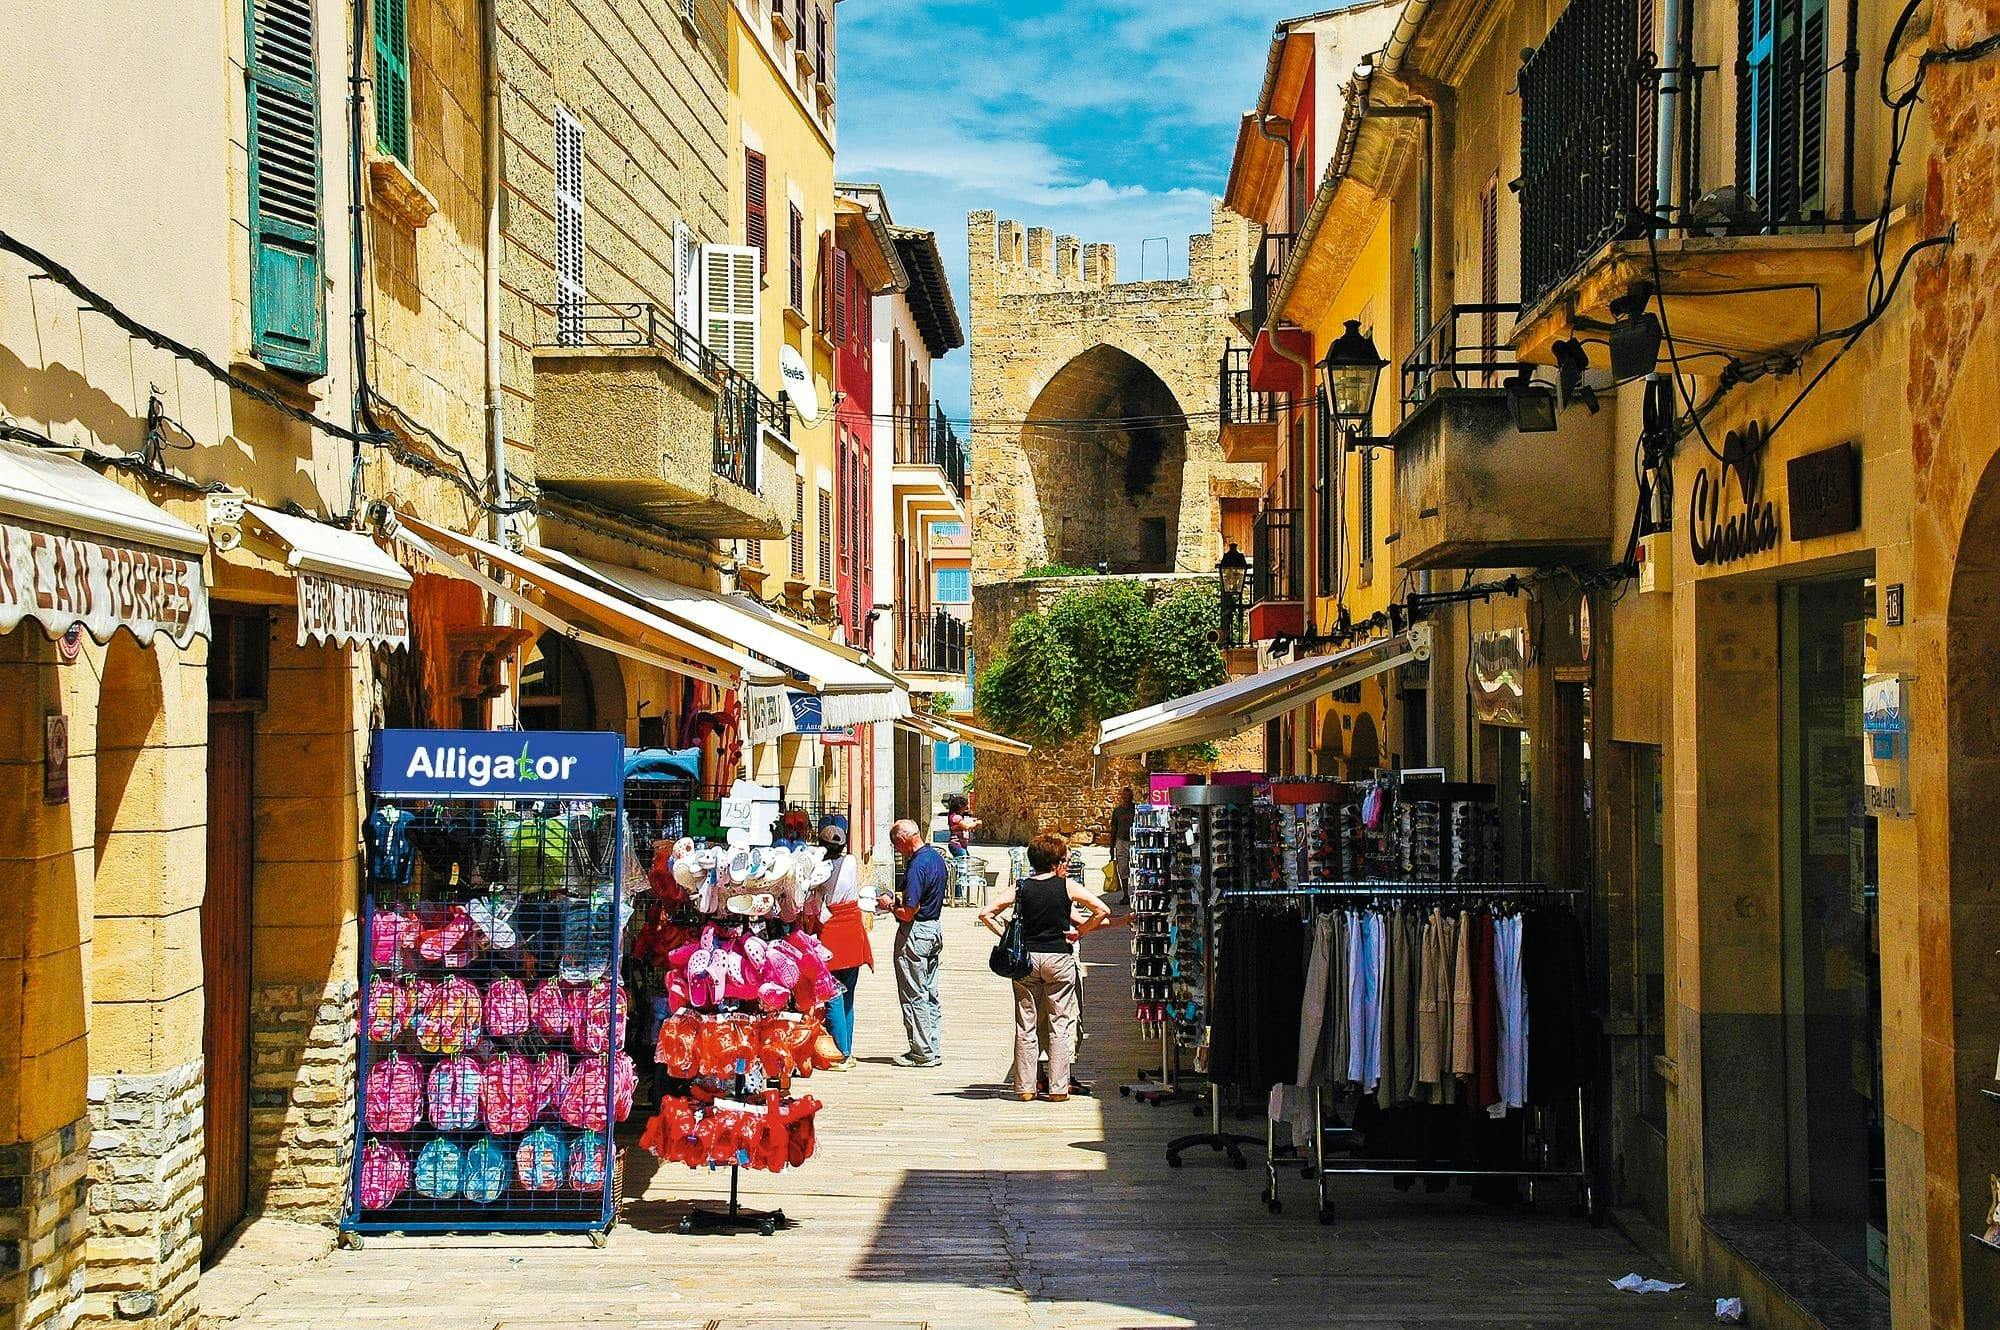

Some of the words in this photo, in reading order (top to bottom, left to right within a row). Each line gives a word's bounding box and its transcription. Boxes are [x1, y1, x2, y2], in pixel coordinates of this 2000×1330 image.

[30, 533, 93, 616] CAN
[100, 545, 193, 625] TORRES
[303, 575, 337, 635] FORN
[342, 585, 367, 634] CAN
[368, 590, 407, 637] TORRES
[1888, 592, 1898, 618] 16
[405, 739, 578, 787] Alligator
[1883, 786, 1896, 809] 416
